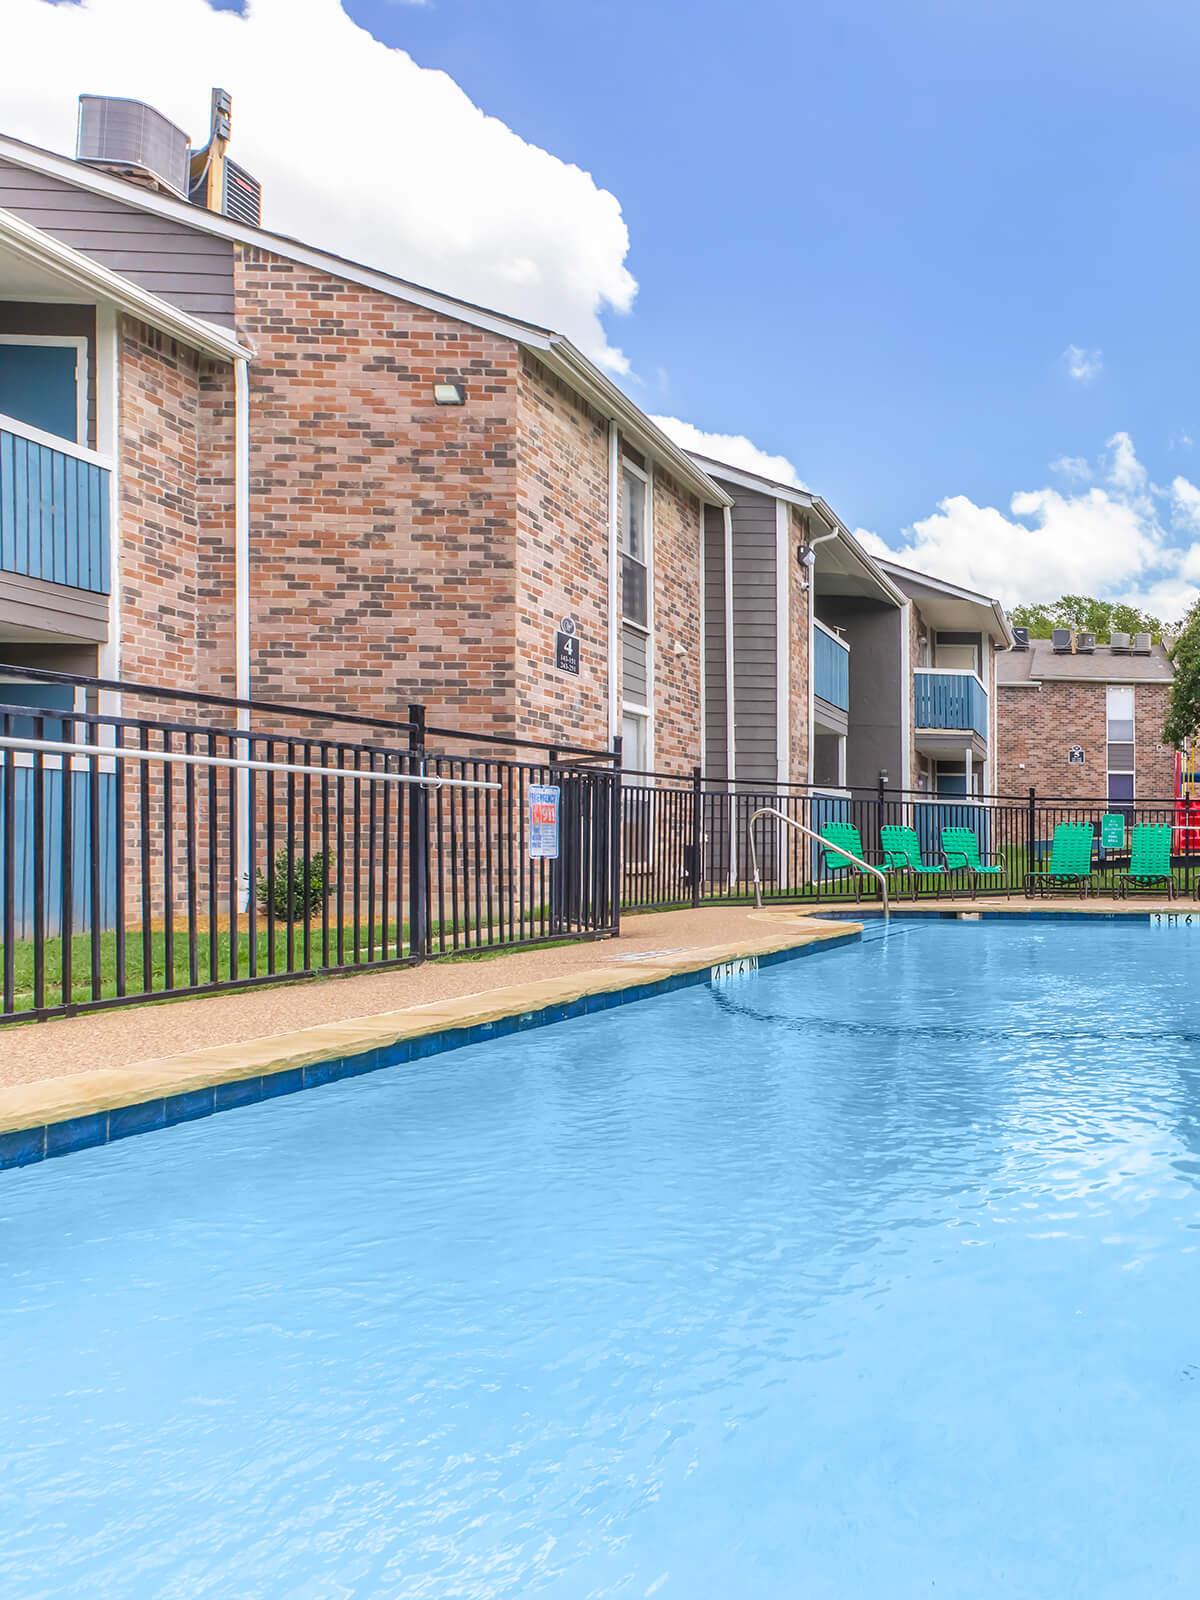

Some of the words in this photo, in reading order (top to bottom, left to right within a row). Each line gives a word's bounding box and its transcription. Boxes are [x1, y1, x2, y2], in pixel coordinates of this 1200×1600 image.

[563, 638, 573, 655] 4
[1167, 913, 1179, 925] FT
[1185, 914, 1192, 925] 6
[725, 962, 734, 976] FT
[738, 960, 744, 975] 6
